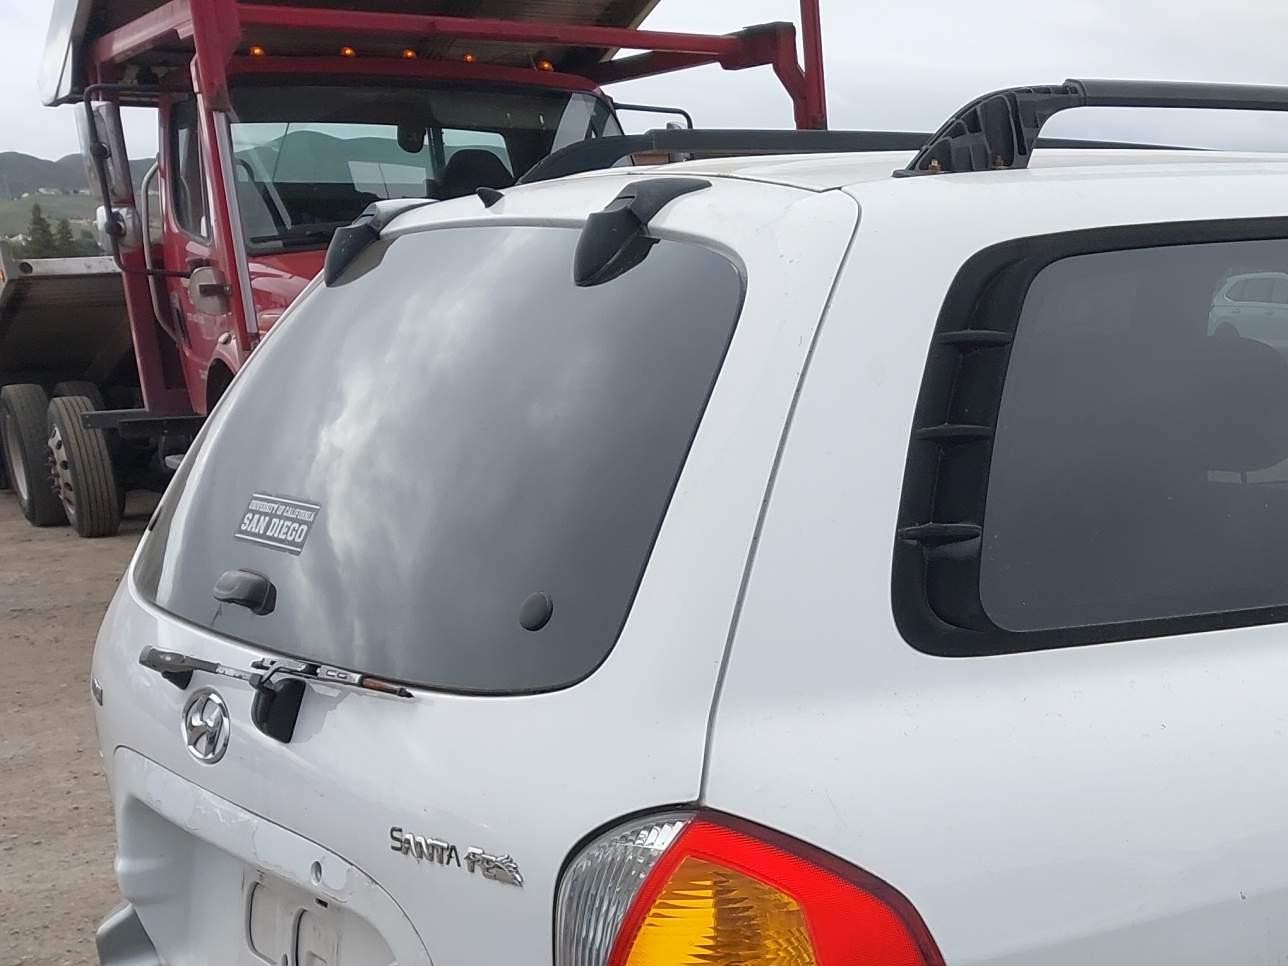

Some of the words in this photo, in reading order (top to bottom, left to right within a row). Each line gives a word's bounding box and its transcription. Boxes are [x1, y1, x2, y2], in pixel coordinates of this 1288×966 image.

[248, 500, 279, 514] UNIVERSITY
[283, 506, 315, 522] CALIFORNIA
[240, 512, 269, 535] SAN
[266, 518, 308, 542] DIEGO
[390, 826, 461, 867] SANTA
